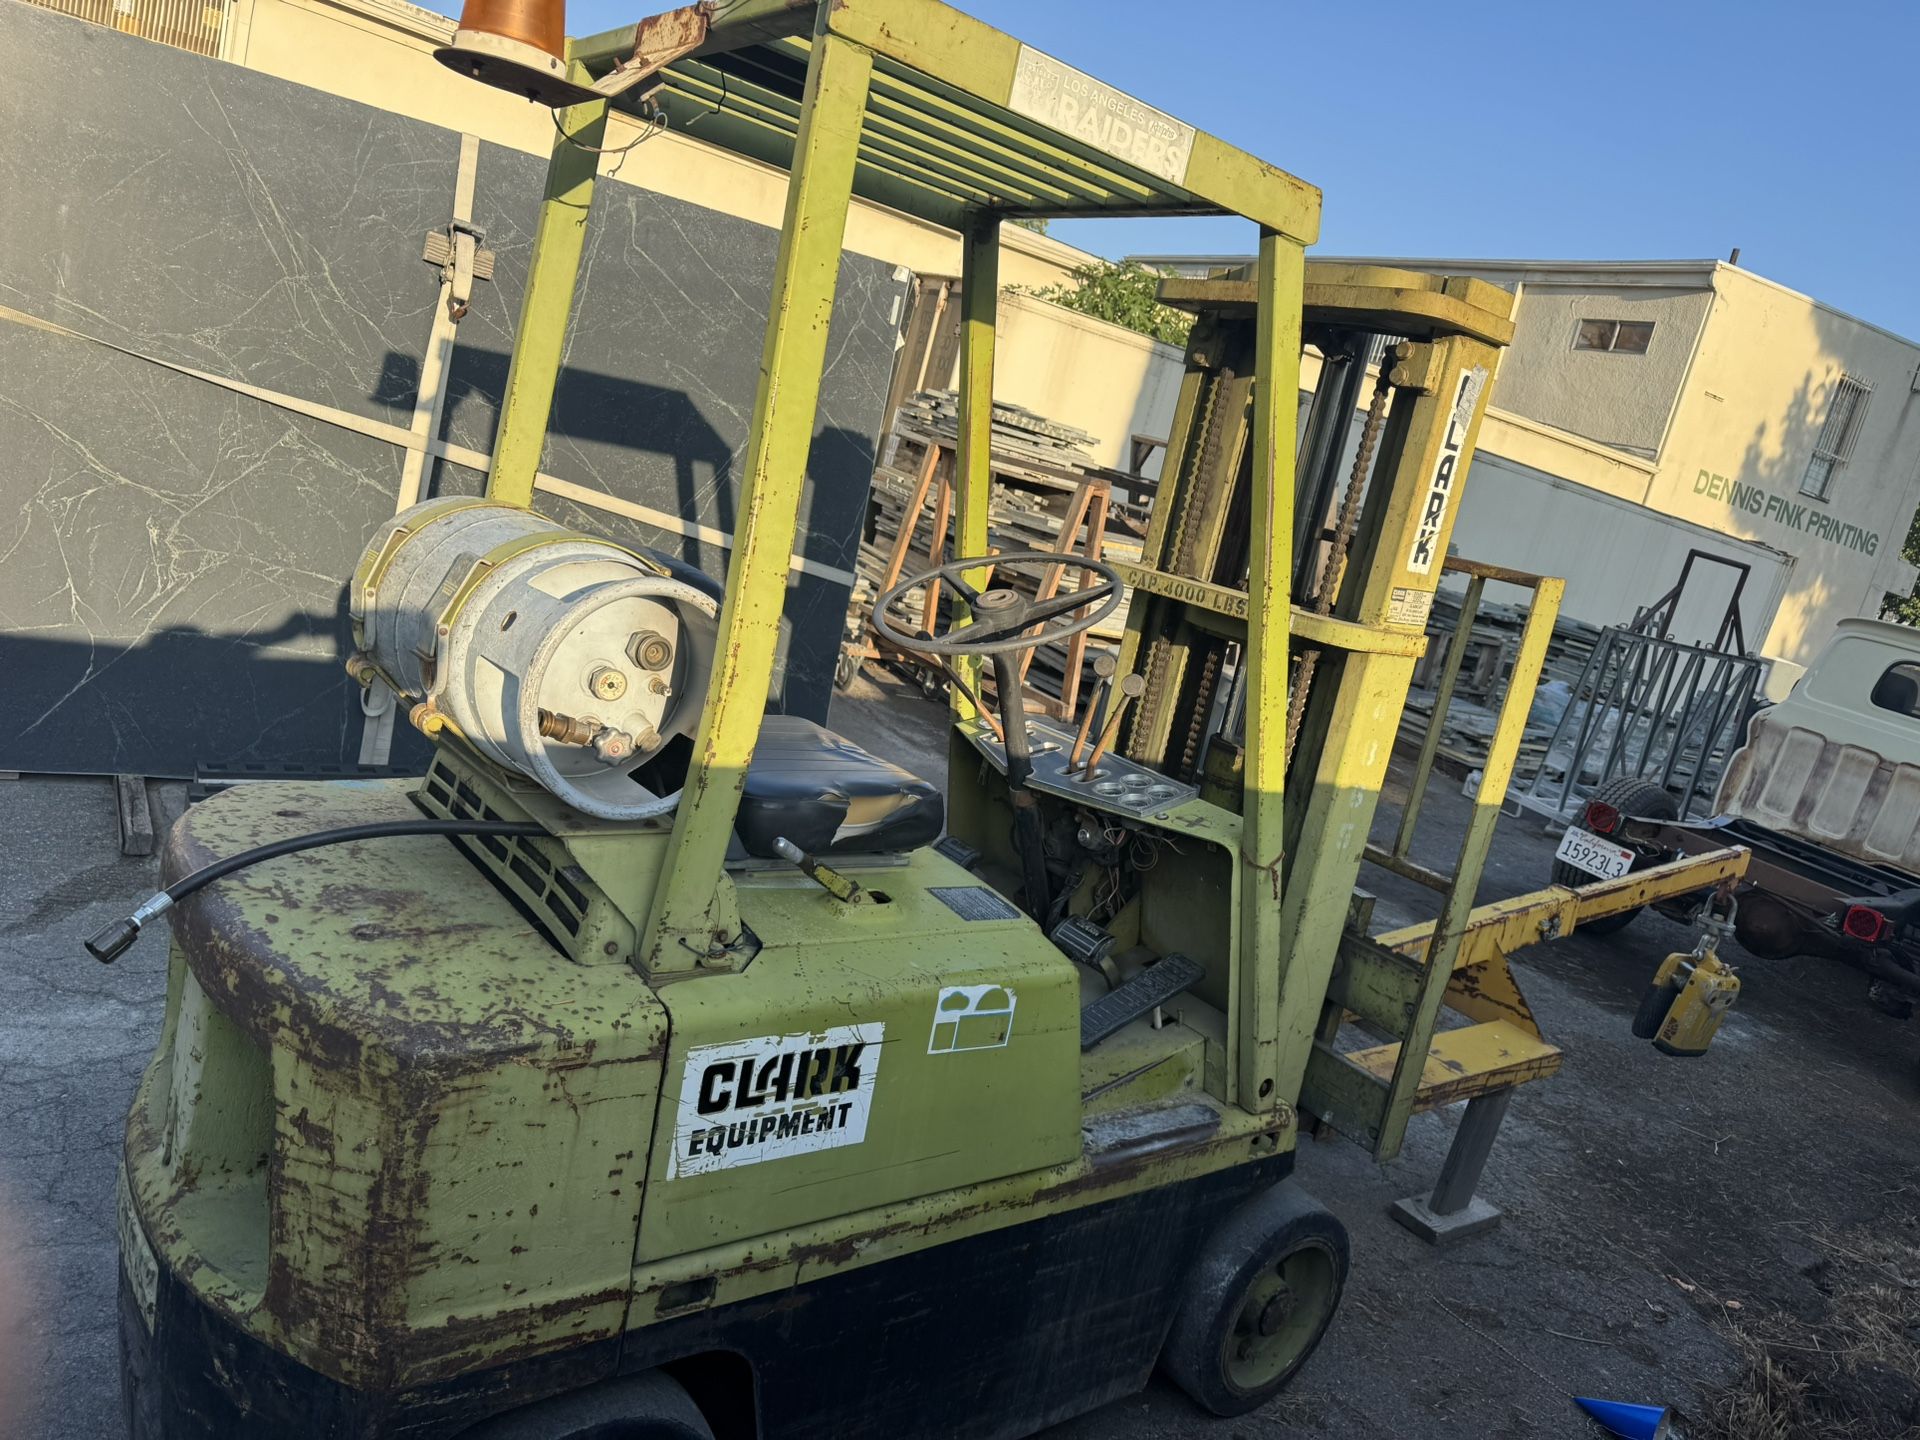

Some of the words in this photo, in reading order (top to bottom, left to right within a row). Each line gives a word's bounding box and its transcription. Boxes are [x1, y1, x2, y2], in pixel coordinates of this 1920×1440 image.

[1063, 75, 1090, 98] LOS
[1090, 89, 1146, 125] ANGELES
[1056, 92, 1180, 175] RAIDERS
[1693, 469, 1765, 514] DENNIS
[1763, 495, 1807, 530] FINK
[1805, 511, 1880, 557] PRINTING
[1212, 593, 1247, 615] LBS
[1561, 840, 1624, 878] 15923L3
[697, 1042, 866, 1116] CLARK
[687, 1102, 853, 1156] EQUIPMENT
